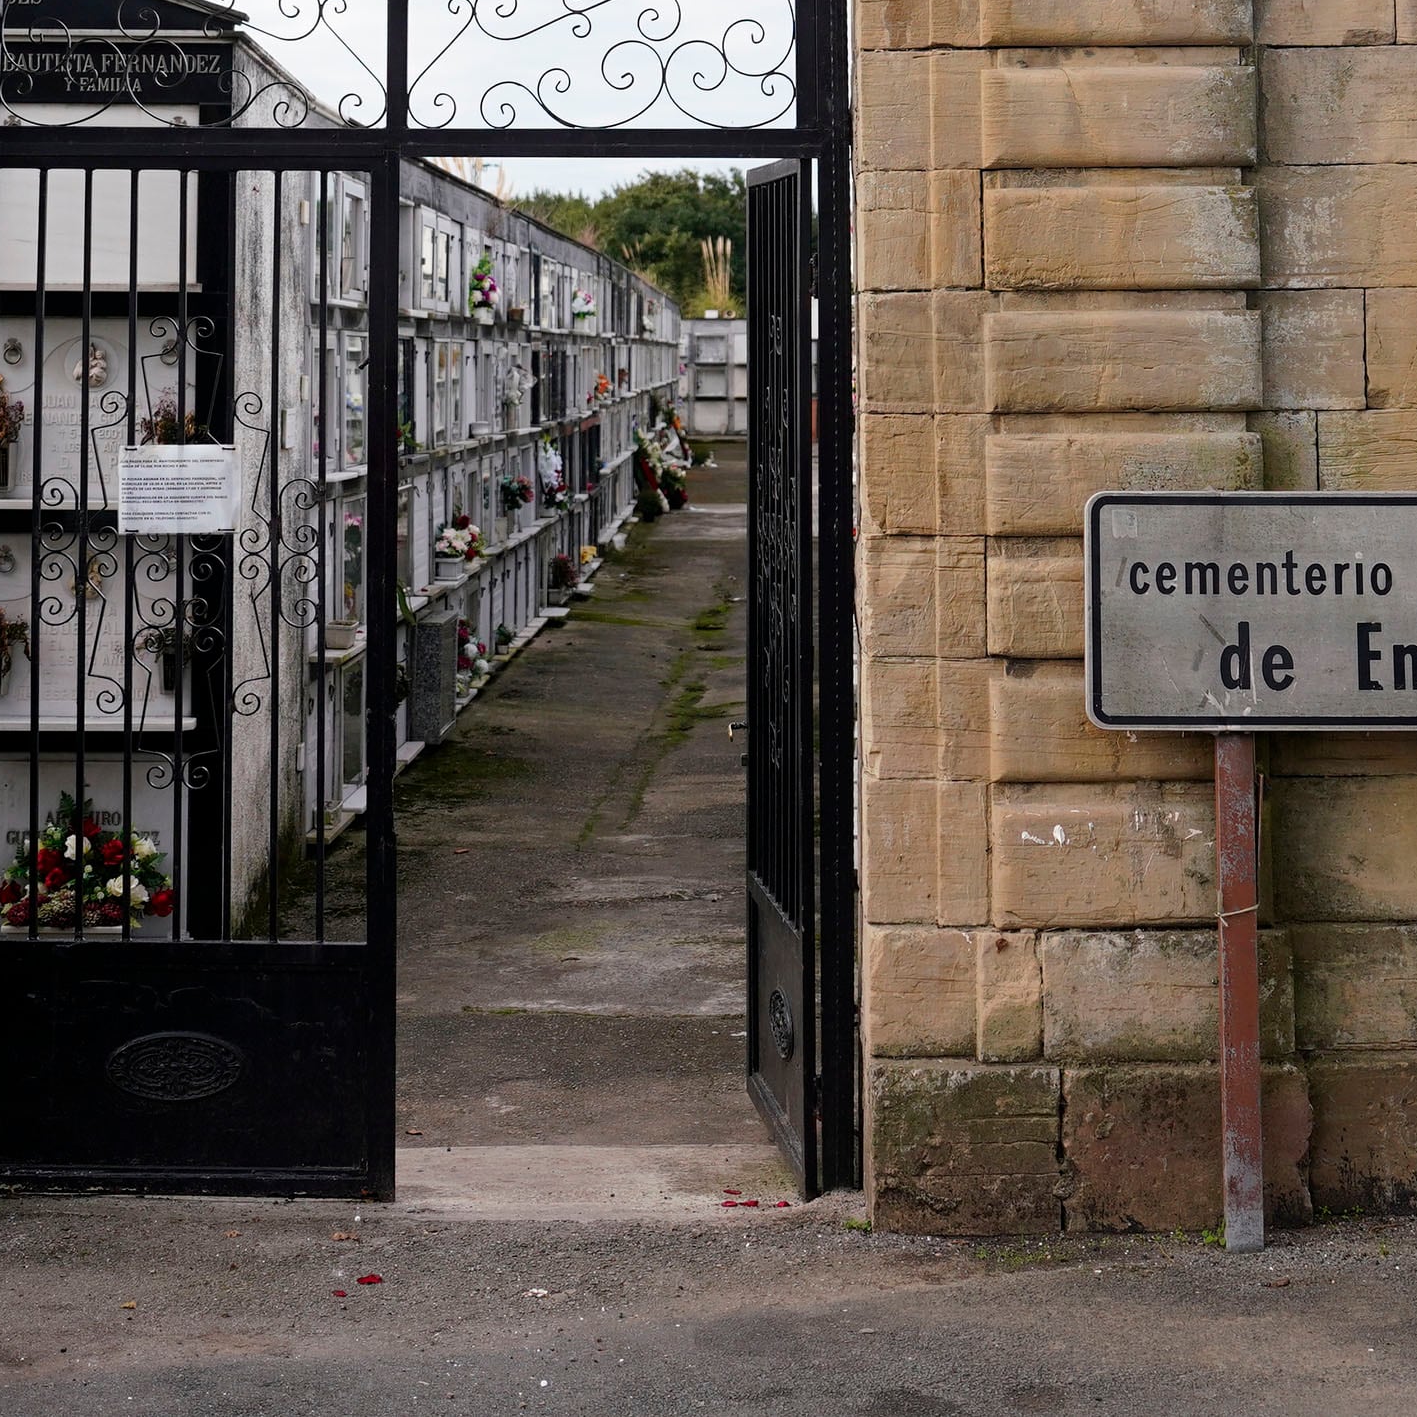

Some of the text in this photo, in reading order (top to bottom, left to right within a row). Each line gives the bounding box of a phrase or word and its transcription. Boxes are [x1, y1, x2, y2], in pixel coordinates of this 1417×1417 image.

[2, 52, 222, 75] BAUTISTA FERNANDEZ
[63, 77, 74, 93] Y
[1128, 549, 1394, 596] cementerio
[1216, 620, 1296, 692] de
